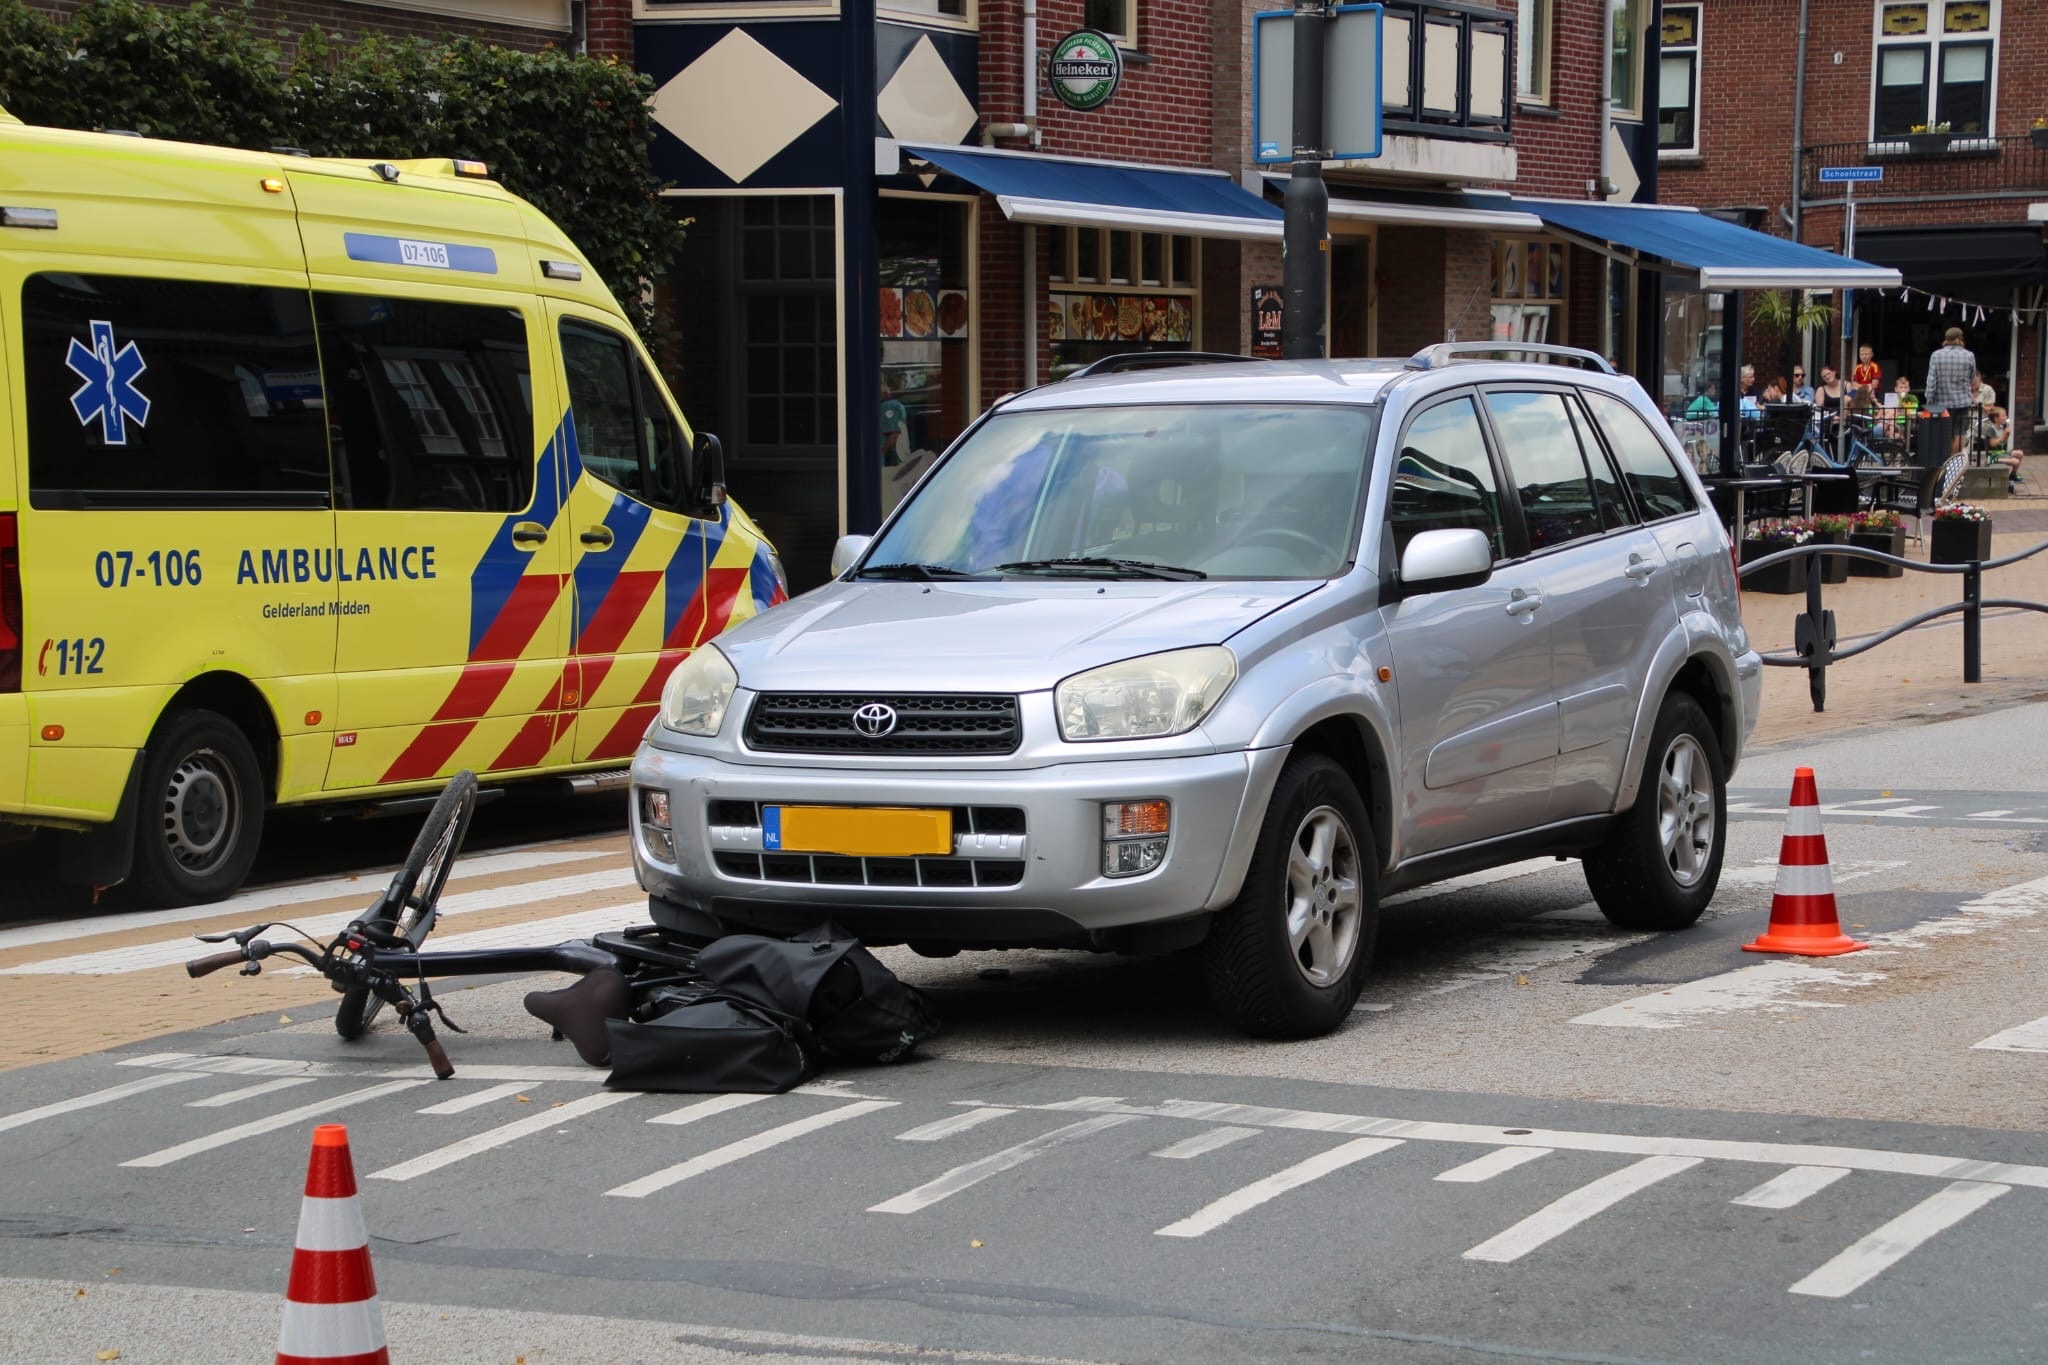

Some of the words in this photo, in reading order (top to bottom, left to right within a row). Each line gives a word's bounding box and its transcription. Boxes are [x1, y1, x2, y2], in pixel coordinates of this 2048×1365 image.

[1055, 63, 1109, 76] Heineken
[1824, 170, 1877, 178] Schoolstraat
[403, 244, 446, 264] 07-106
[1258, 311, 1282, 331] L&M
[95, 549, 202, 588] 07-106
[236, 546, 437, 585] AMBULANCE
[262, 601, 325, 619] Gelderland
[328, 600, 370, 616] Midden
[56, 637, 105, 676] 1-1-2
[766, 832, 779, 843] NL
